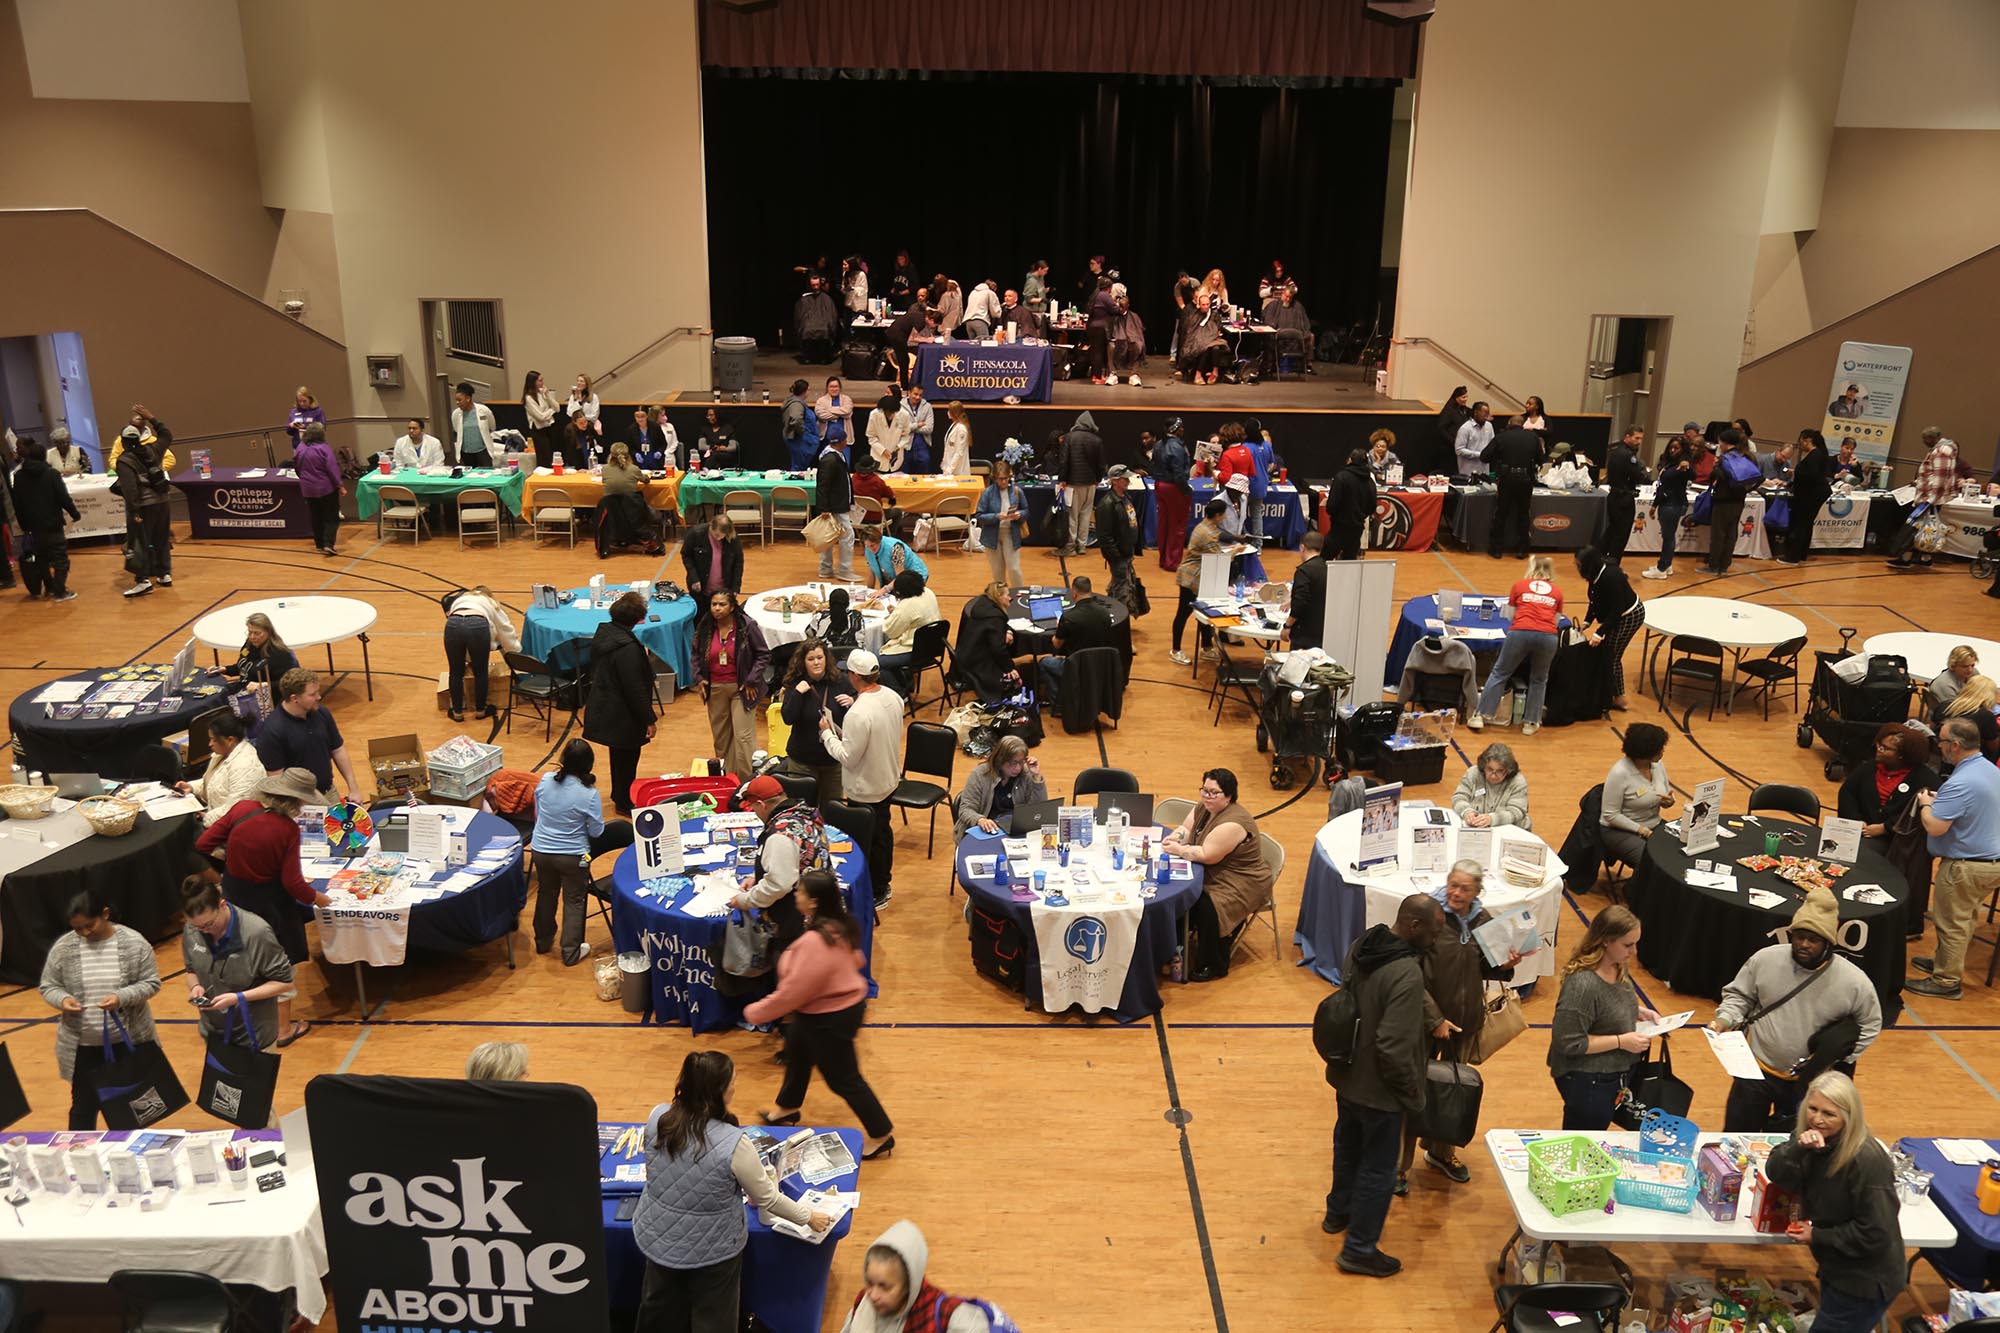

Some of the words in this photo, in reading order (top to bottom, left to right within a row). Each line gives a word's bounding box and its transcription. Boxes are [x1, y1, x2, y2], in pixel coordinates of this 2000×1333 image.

[939, 360, 964, 373] PSC
[973, 360, 1027, 369] PENSACOLA
[1856, 362, 1903, 371] WATERFRONT
[936, 376, 1028, 388] COSMETOLOGY
[230, 488, 273, 498] epilepsy
[1703, 784, 1717, 793] TRIO
[334, 909, 400, 922] ENDEAVORS
[1766, 919, 1869, 951] TO
[1056, 964, 1081, 979] Legal
[344, 1156, 532, 1234] ask
[422, 1234, 591, 1295] me
[359, 1288, 534, 1327] ABOUT
